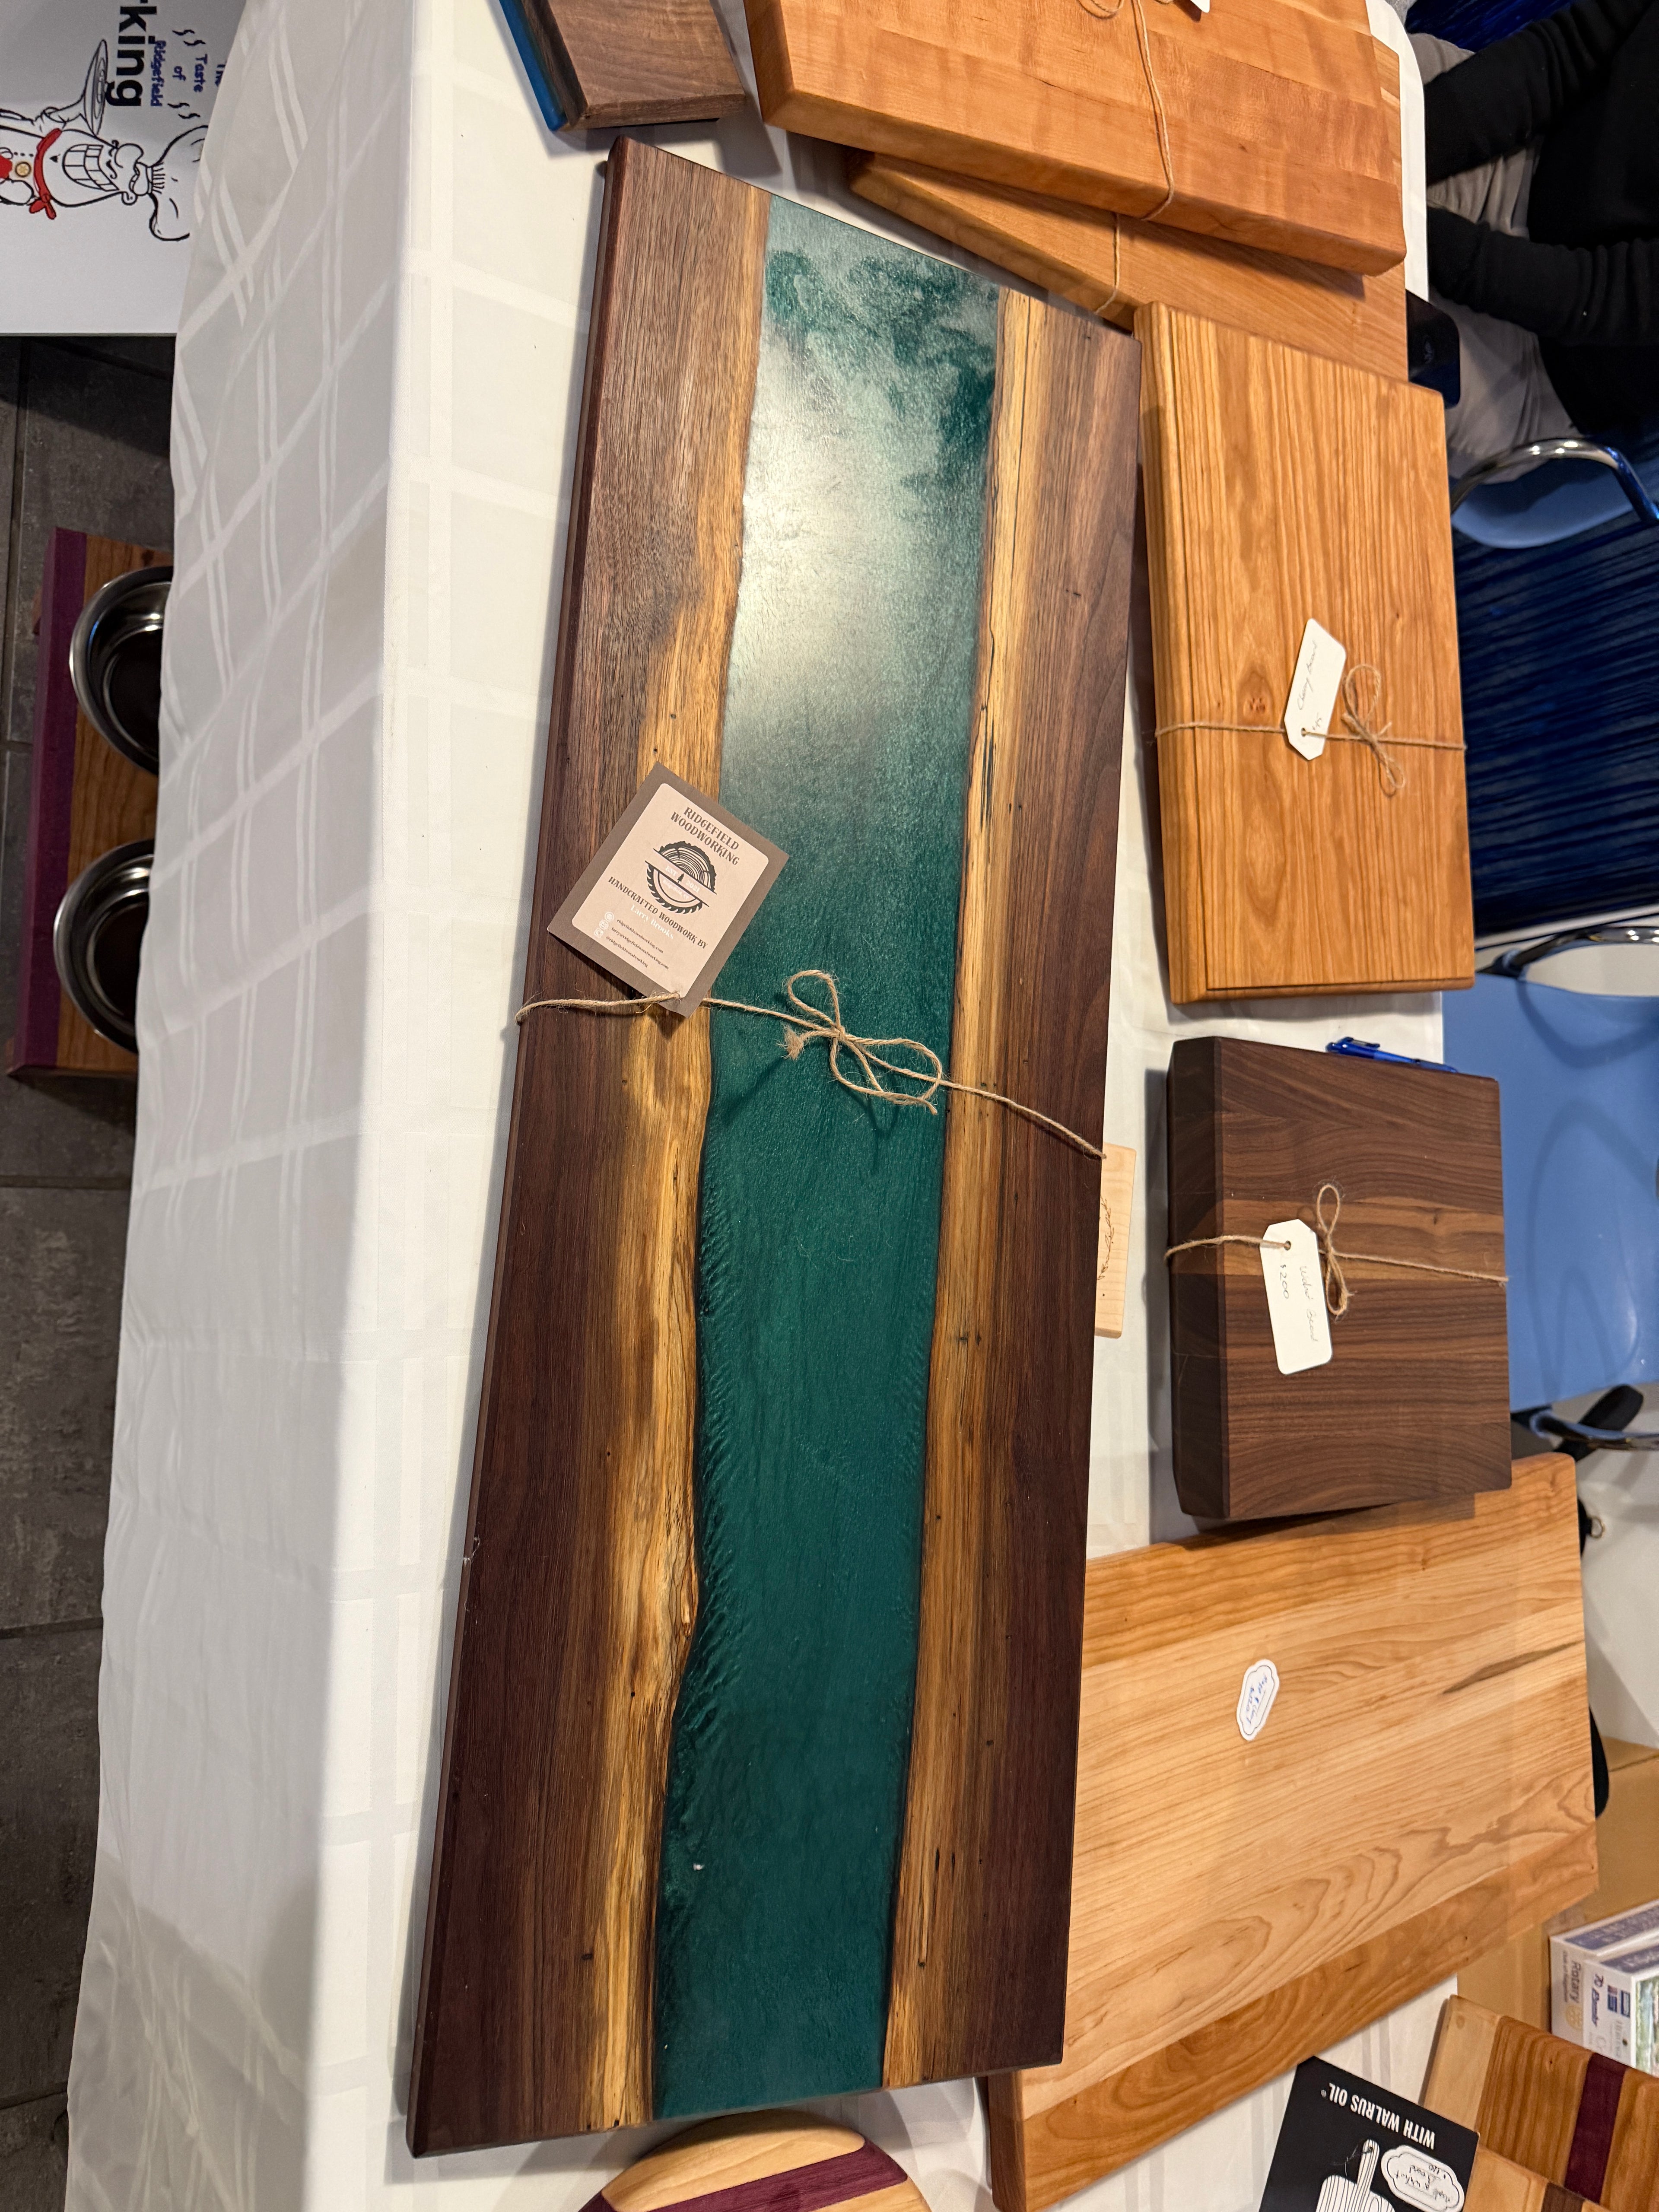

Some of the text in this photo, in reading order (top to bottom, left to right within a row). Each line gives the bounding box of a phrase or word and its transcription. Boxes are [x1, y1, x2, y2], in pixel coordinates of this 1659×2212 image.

[106, 0, 157, 106] king
[151, 40, 166, 106] Ridgefield
[173, 66, 186, 81] of
[194, 54, 207, 92] Taste
[1306, 640, 1317, 674] Board
[671, 811, 740, 865] WOODWORKING
[683, 807, 739, 850] RIDGEFIELD
[665, 865, 700, 893] EST 2021
[608, 877, 708, 949] HANDCRAFTED WOODWORK BY
[630, 904, 673, 939] Larry Brooks
[1280, 1264, 1289, 1299] $200
[1570, 1960, 1581, 2003] Rotary
[1350, 2094, 1400, 2133] WALRUS
[1403, 2119, 1435, 2150] WITH
